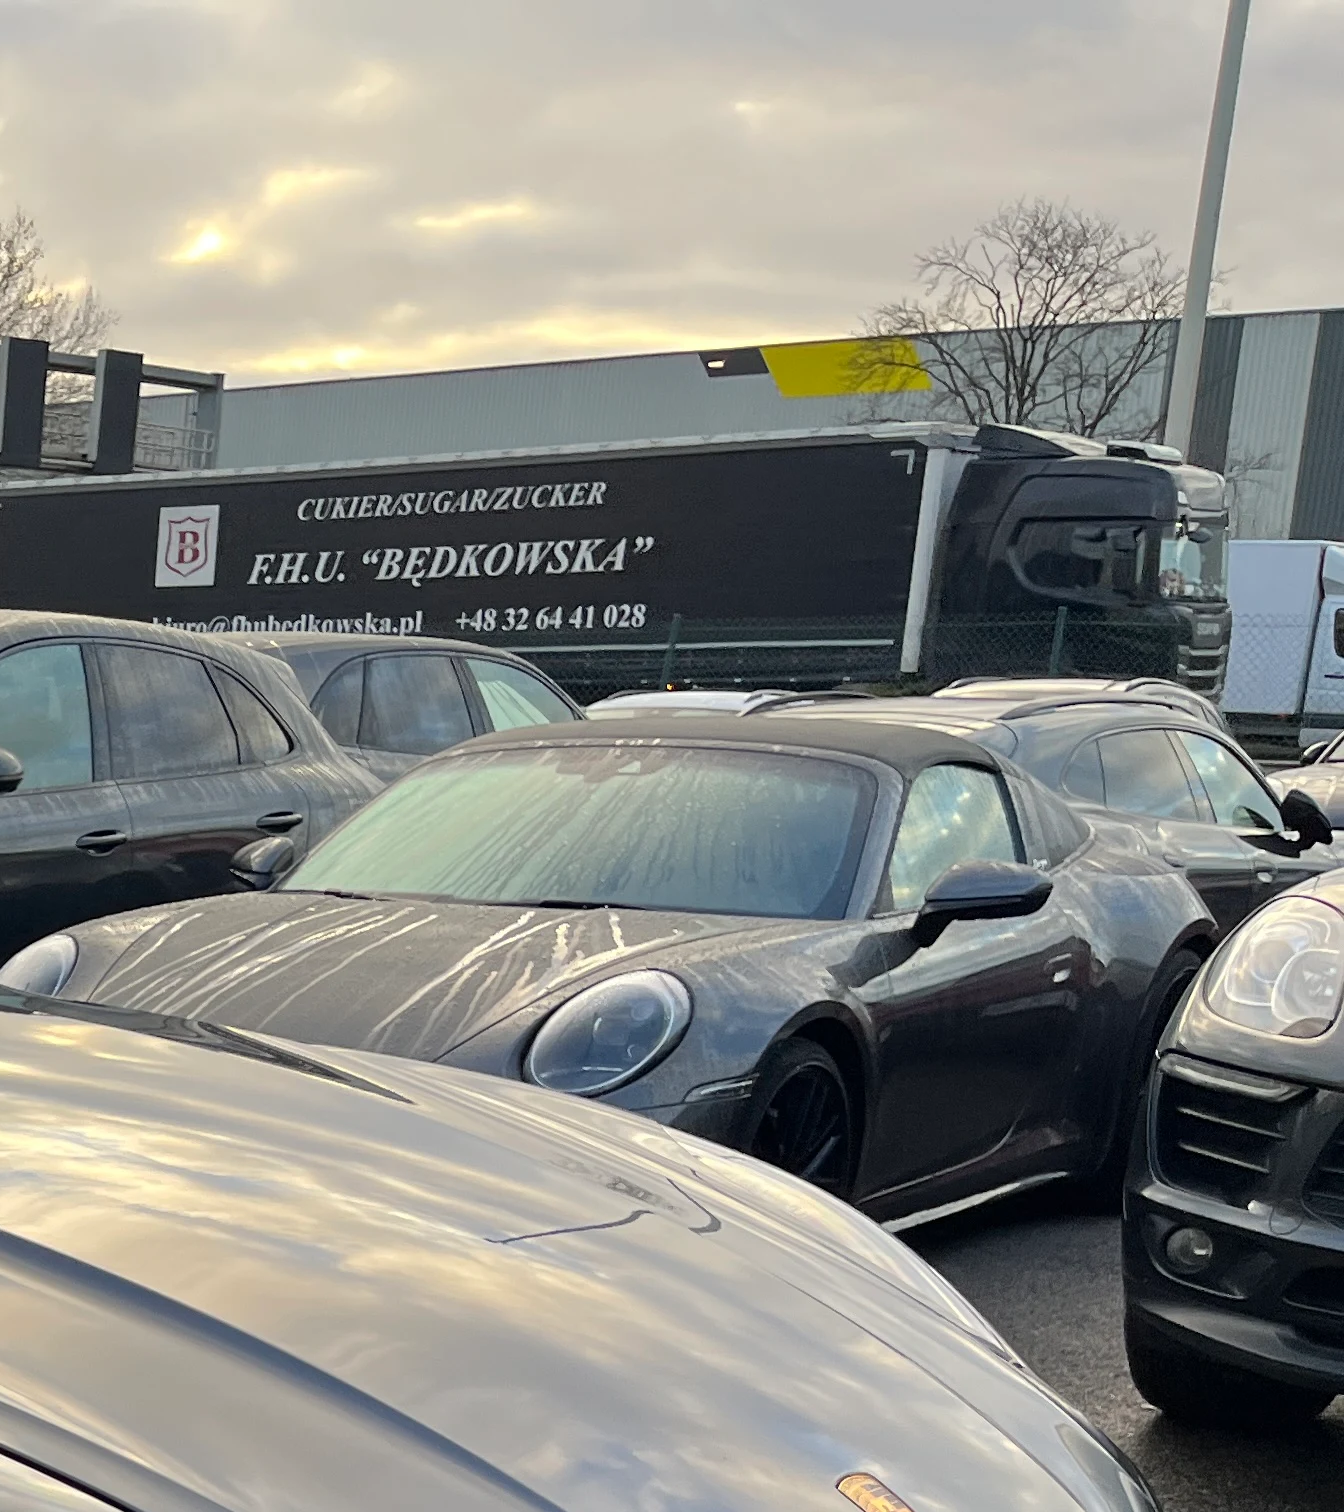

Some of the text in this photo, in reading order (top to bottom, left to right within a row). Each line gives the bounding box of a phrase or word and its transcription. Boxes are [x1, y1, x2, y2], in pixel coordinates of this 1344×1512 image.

[296, 480, 609, 522] CUKIER/SUGAR/ZUCKER
[246, 550, 346, 586] F.H.U.
[455, 607, 497, 632] +48
[501, 607, 530, 632] 32
[535, 605, 563, 630] 64
[568, 604, 595, 629] 41
[603, 603, 647, 628] 028
